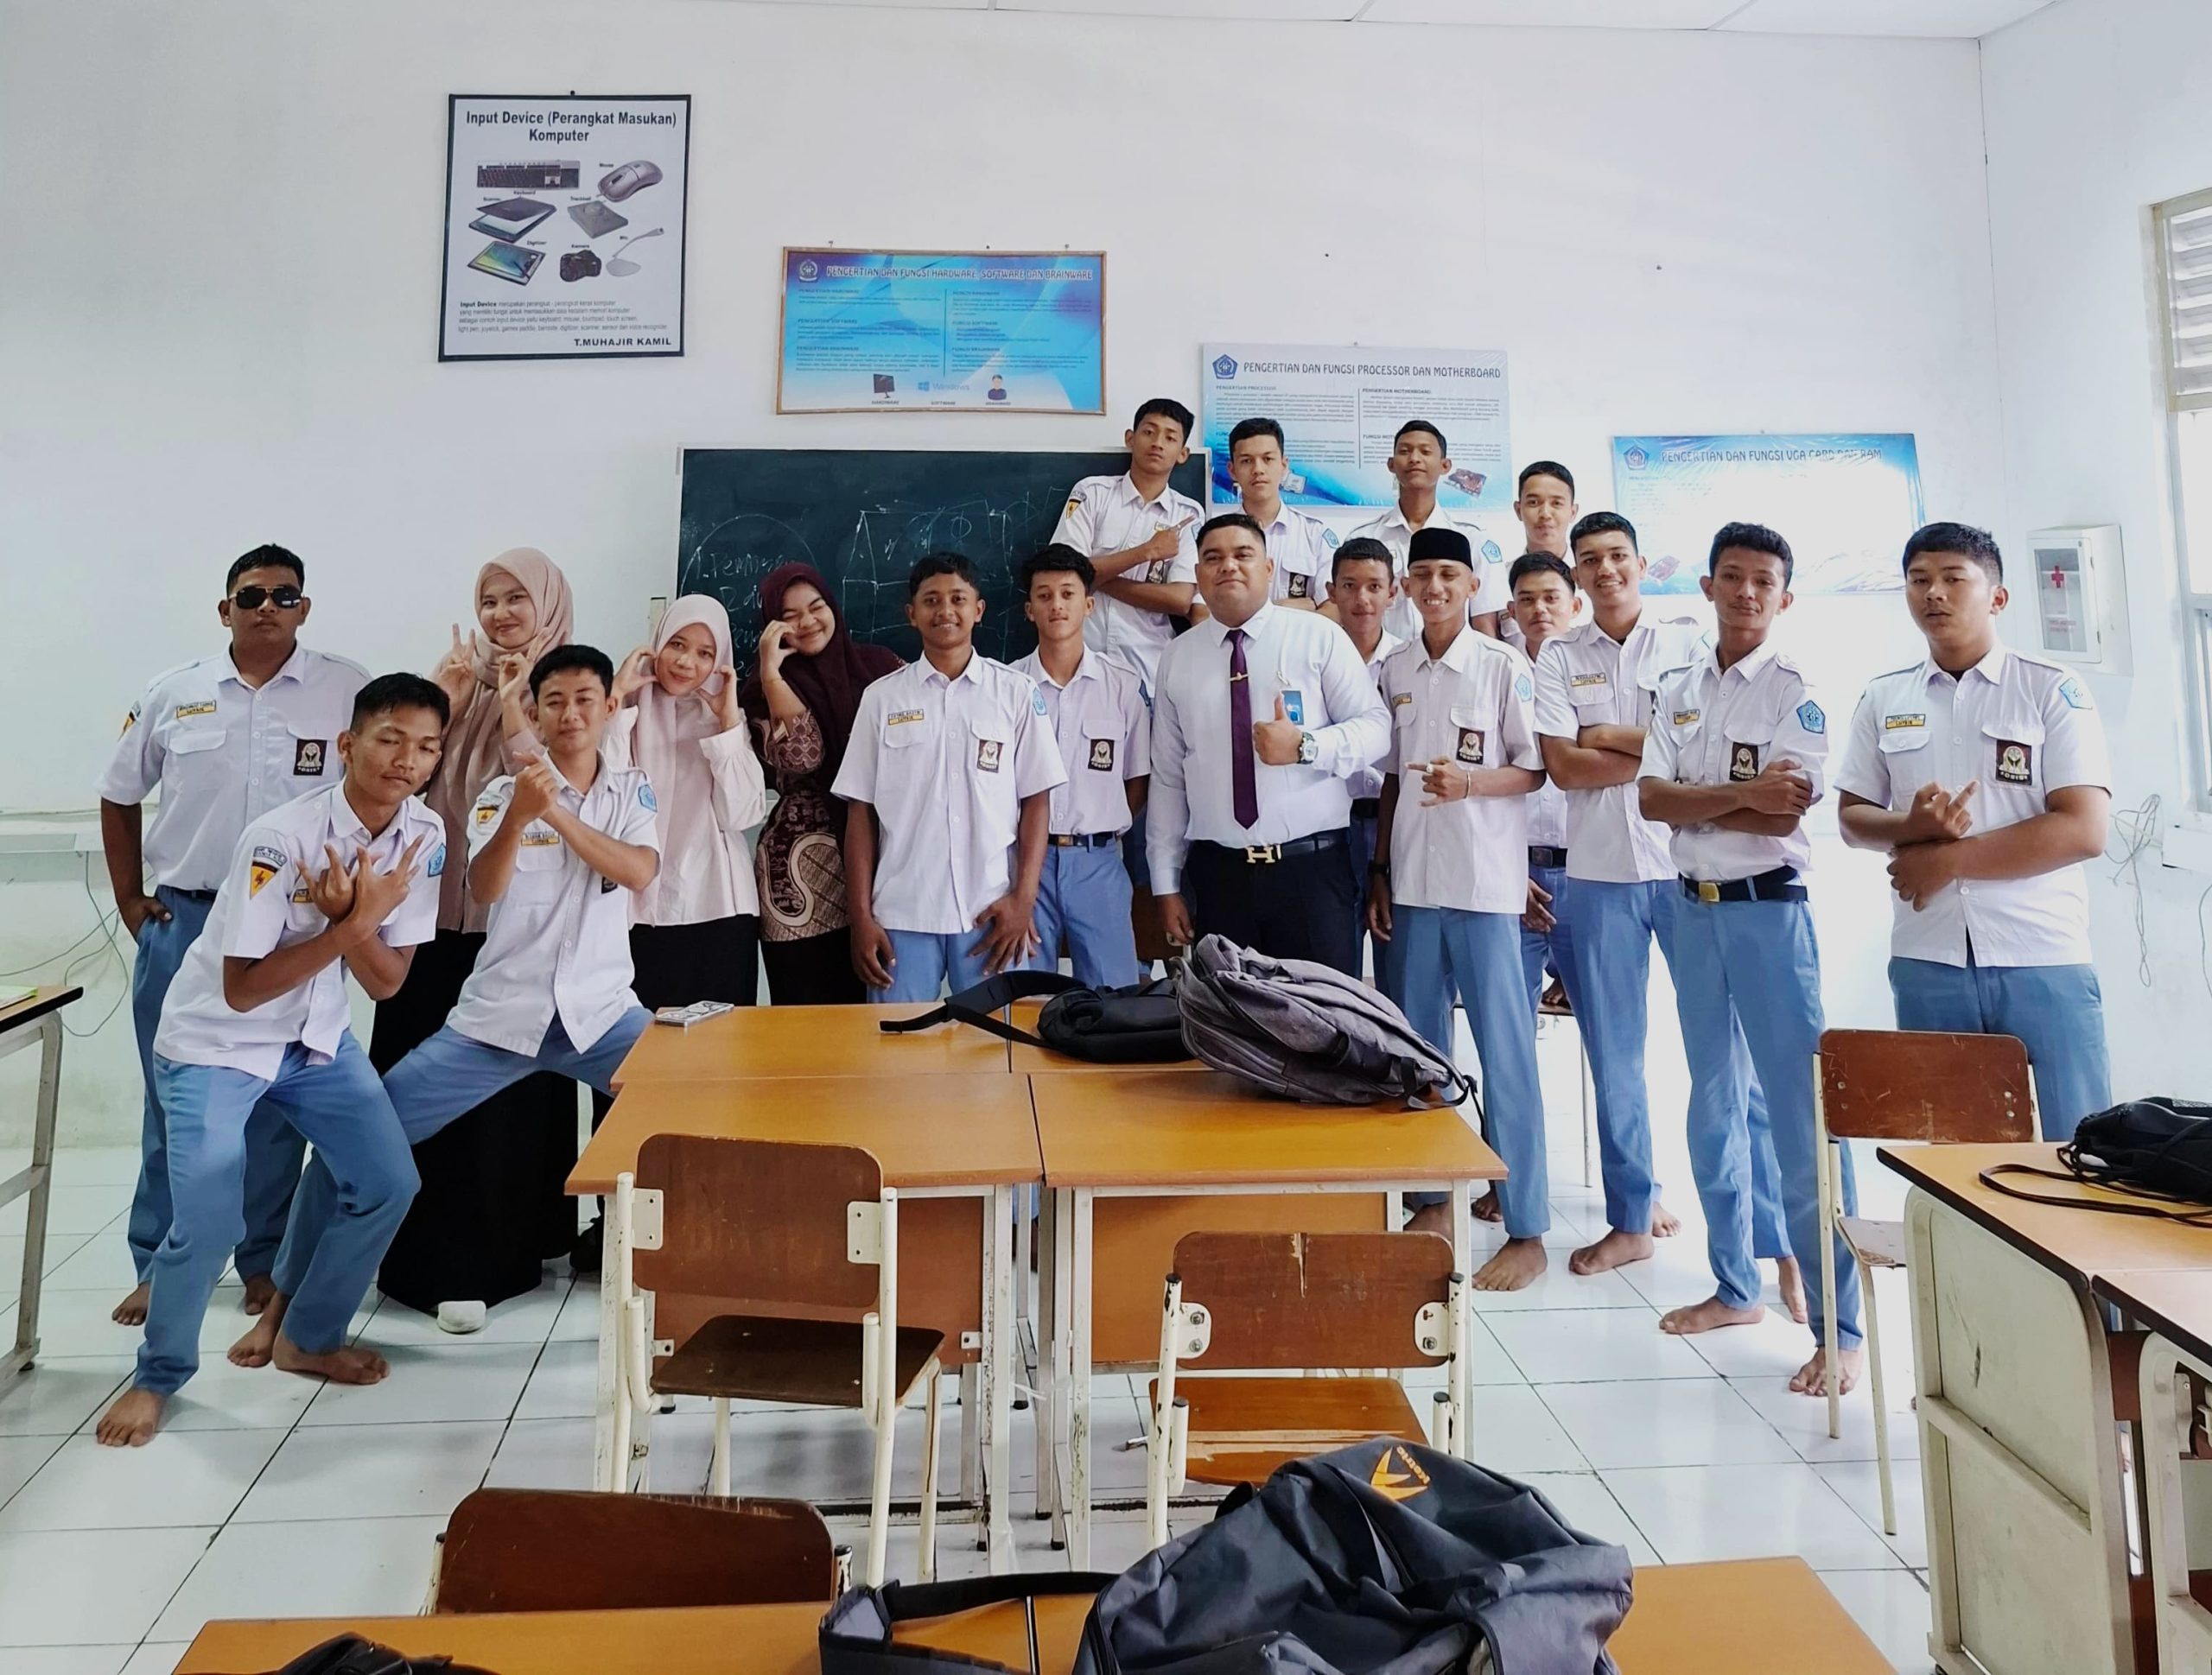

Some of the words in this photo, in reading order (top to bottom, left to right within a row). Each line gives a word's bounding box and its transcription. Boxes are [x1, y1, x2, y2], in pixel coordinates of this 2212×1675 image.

[466, 111, 498, 127] Input
[502, 111, 543, 124] Device
[548, 111, 614, 127] (Perangkat
[618, 111, 677, 129] Masukan)
[529, 128, 589, 144] Komputer
[827, 266, 880, 276] PENGERTIAN
[880, 267, 898, 277] DAN
[900, 268, 929, 278] FUNGSI
[982, 270, 1024, 279] SOFTWARE
[1027, 270, 1043, 279] DAN
[1046, 270, 1092, 280] BRAINWARE
[574, 338, 632, 346] T.MUHAJIR
[1243, 362, 1299, 373] PENGERTIAN
[1302, 363, 1321, 374] DAN
[1323, 364, 1355, 375] FUNGSI
[1357, 365, 1410, 376] PROCESSOR
[1413, 366, 1431, 377] DAN
[1433, 367, 1501, 378] MOTHERBOARD
[1661, 449, 1723, 461] PENGERTIAN
[1726, 449, 1746, 461] DAN
[1748, 449, 1783, 461] FUNGSI
[1786, 449, 1806, 461] VGA
